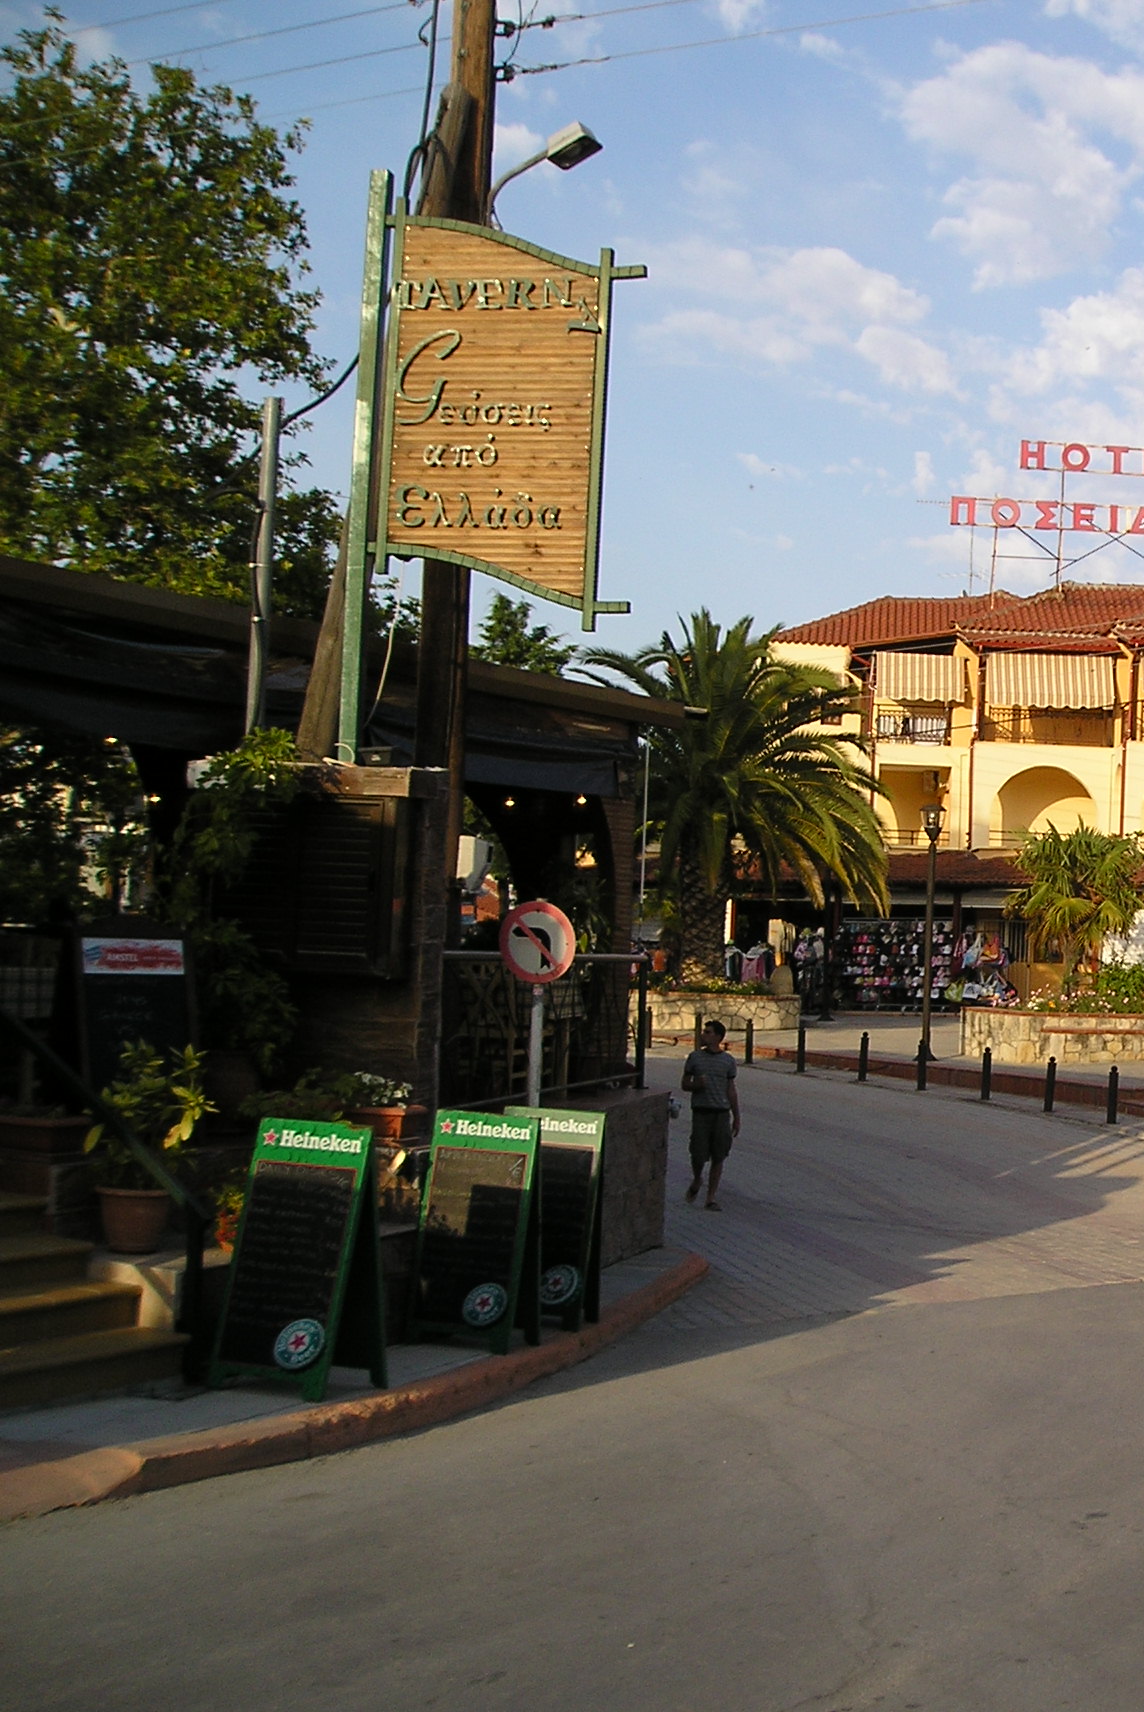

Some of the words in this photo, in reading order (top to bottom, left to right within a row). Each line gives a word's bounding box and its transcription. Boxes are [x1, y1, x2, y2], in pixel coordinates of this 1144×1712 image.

[422, 433, 498, 468] από
[455, 1119, 532, 1140] Heineken
[540, 1117, 598, 1134] eineken
[279, 1129, 363, 1153] Heineken
